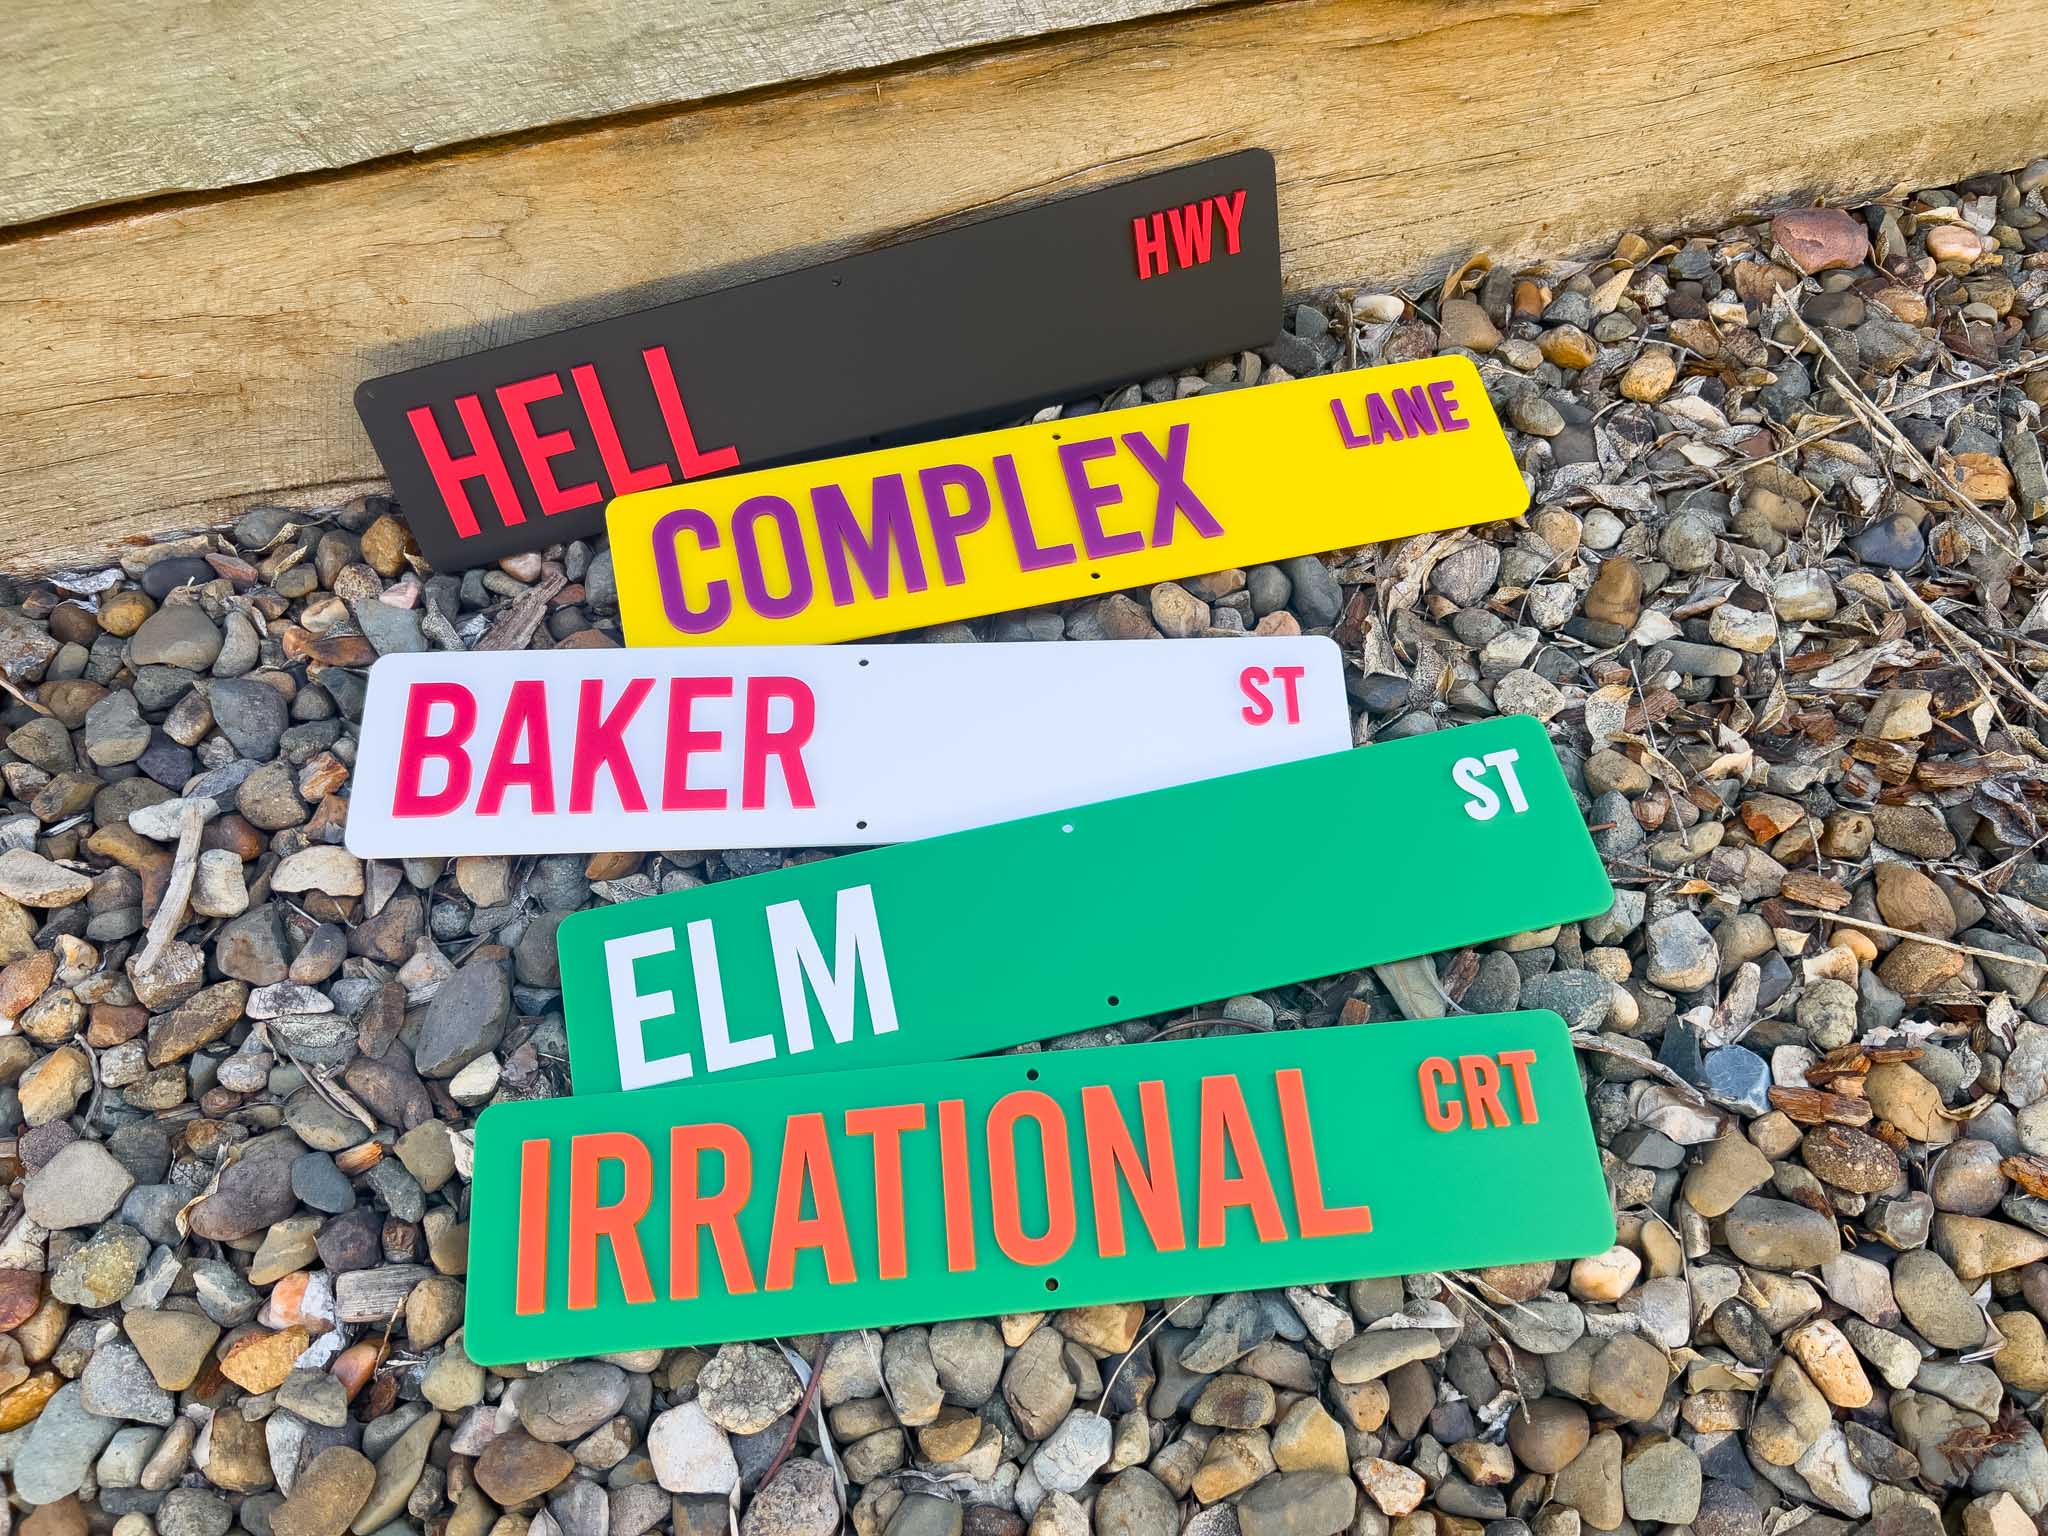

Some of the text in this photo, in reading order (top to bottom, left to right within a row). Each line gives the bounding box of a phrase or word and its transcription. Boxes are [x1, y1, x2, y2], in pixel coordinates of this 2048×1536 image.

[406, 190, 1247, 539] HELL HWY
[653, 380, 1470, 633] COMPLEX LANE
[392, 666, 1305, 818] BAKER ST
[604, 749, 1530, 1091] ELM ST
[515, 1051, 1538, 1316] IRRATIONAL CRT
